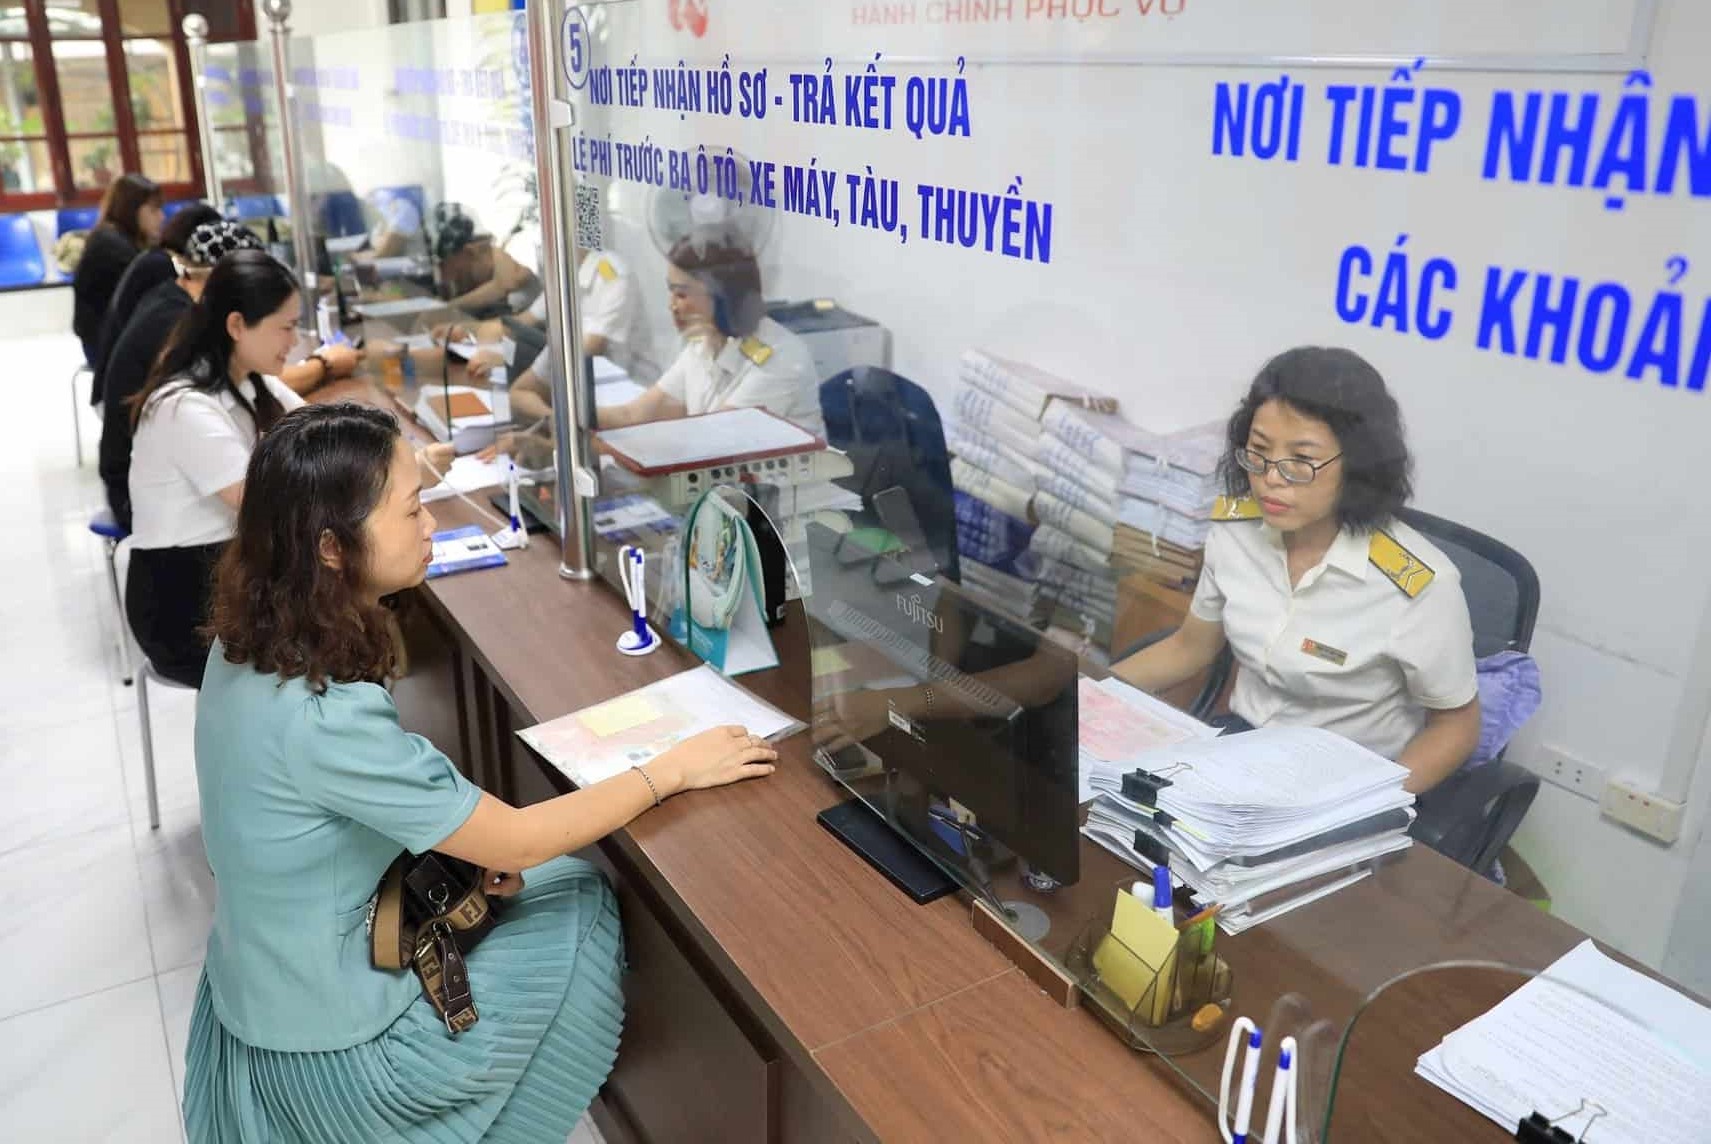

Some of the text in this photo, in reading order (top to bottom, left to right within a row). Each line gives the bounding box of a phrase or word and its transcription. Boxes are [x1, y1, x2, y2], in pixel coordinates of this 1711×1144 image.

[569, 23, 583, 73] 5
[589, 65, 613, 105] NƠI
[616, 54, 648, 107] TIẾP
[653, 60, 701, 121] NHẬN
[707, 53, 732, 116] HỒ
[739, 68, 767, 119] SƠ
[790, 57, 836, 125] TRẢ
[845, 52, 896, 130] KẾT
[906, 56, 971, 139] QUẢ
[1212, 57, 1711, 211] NƠI TIẾP NHẬN
[573, 130, 587, 180] LỆ
[590, 133, 612, 177] PHÍ
[615, 135, 664, 187] TRƯỚC
[669, 150, 691, 201] BẠ
[697, 144, 708, 195] Ô
[713, 147, 743, 207] TÔ,
[749, 160, 776, 209] XE
[783, 157, 840, 227] MÁY,
[846, 165, 907, 244] TÀU,
[917, 175, 1052, 264] THUYỀN
[1335, 233, 1457, 340] CÁC
